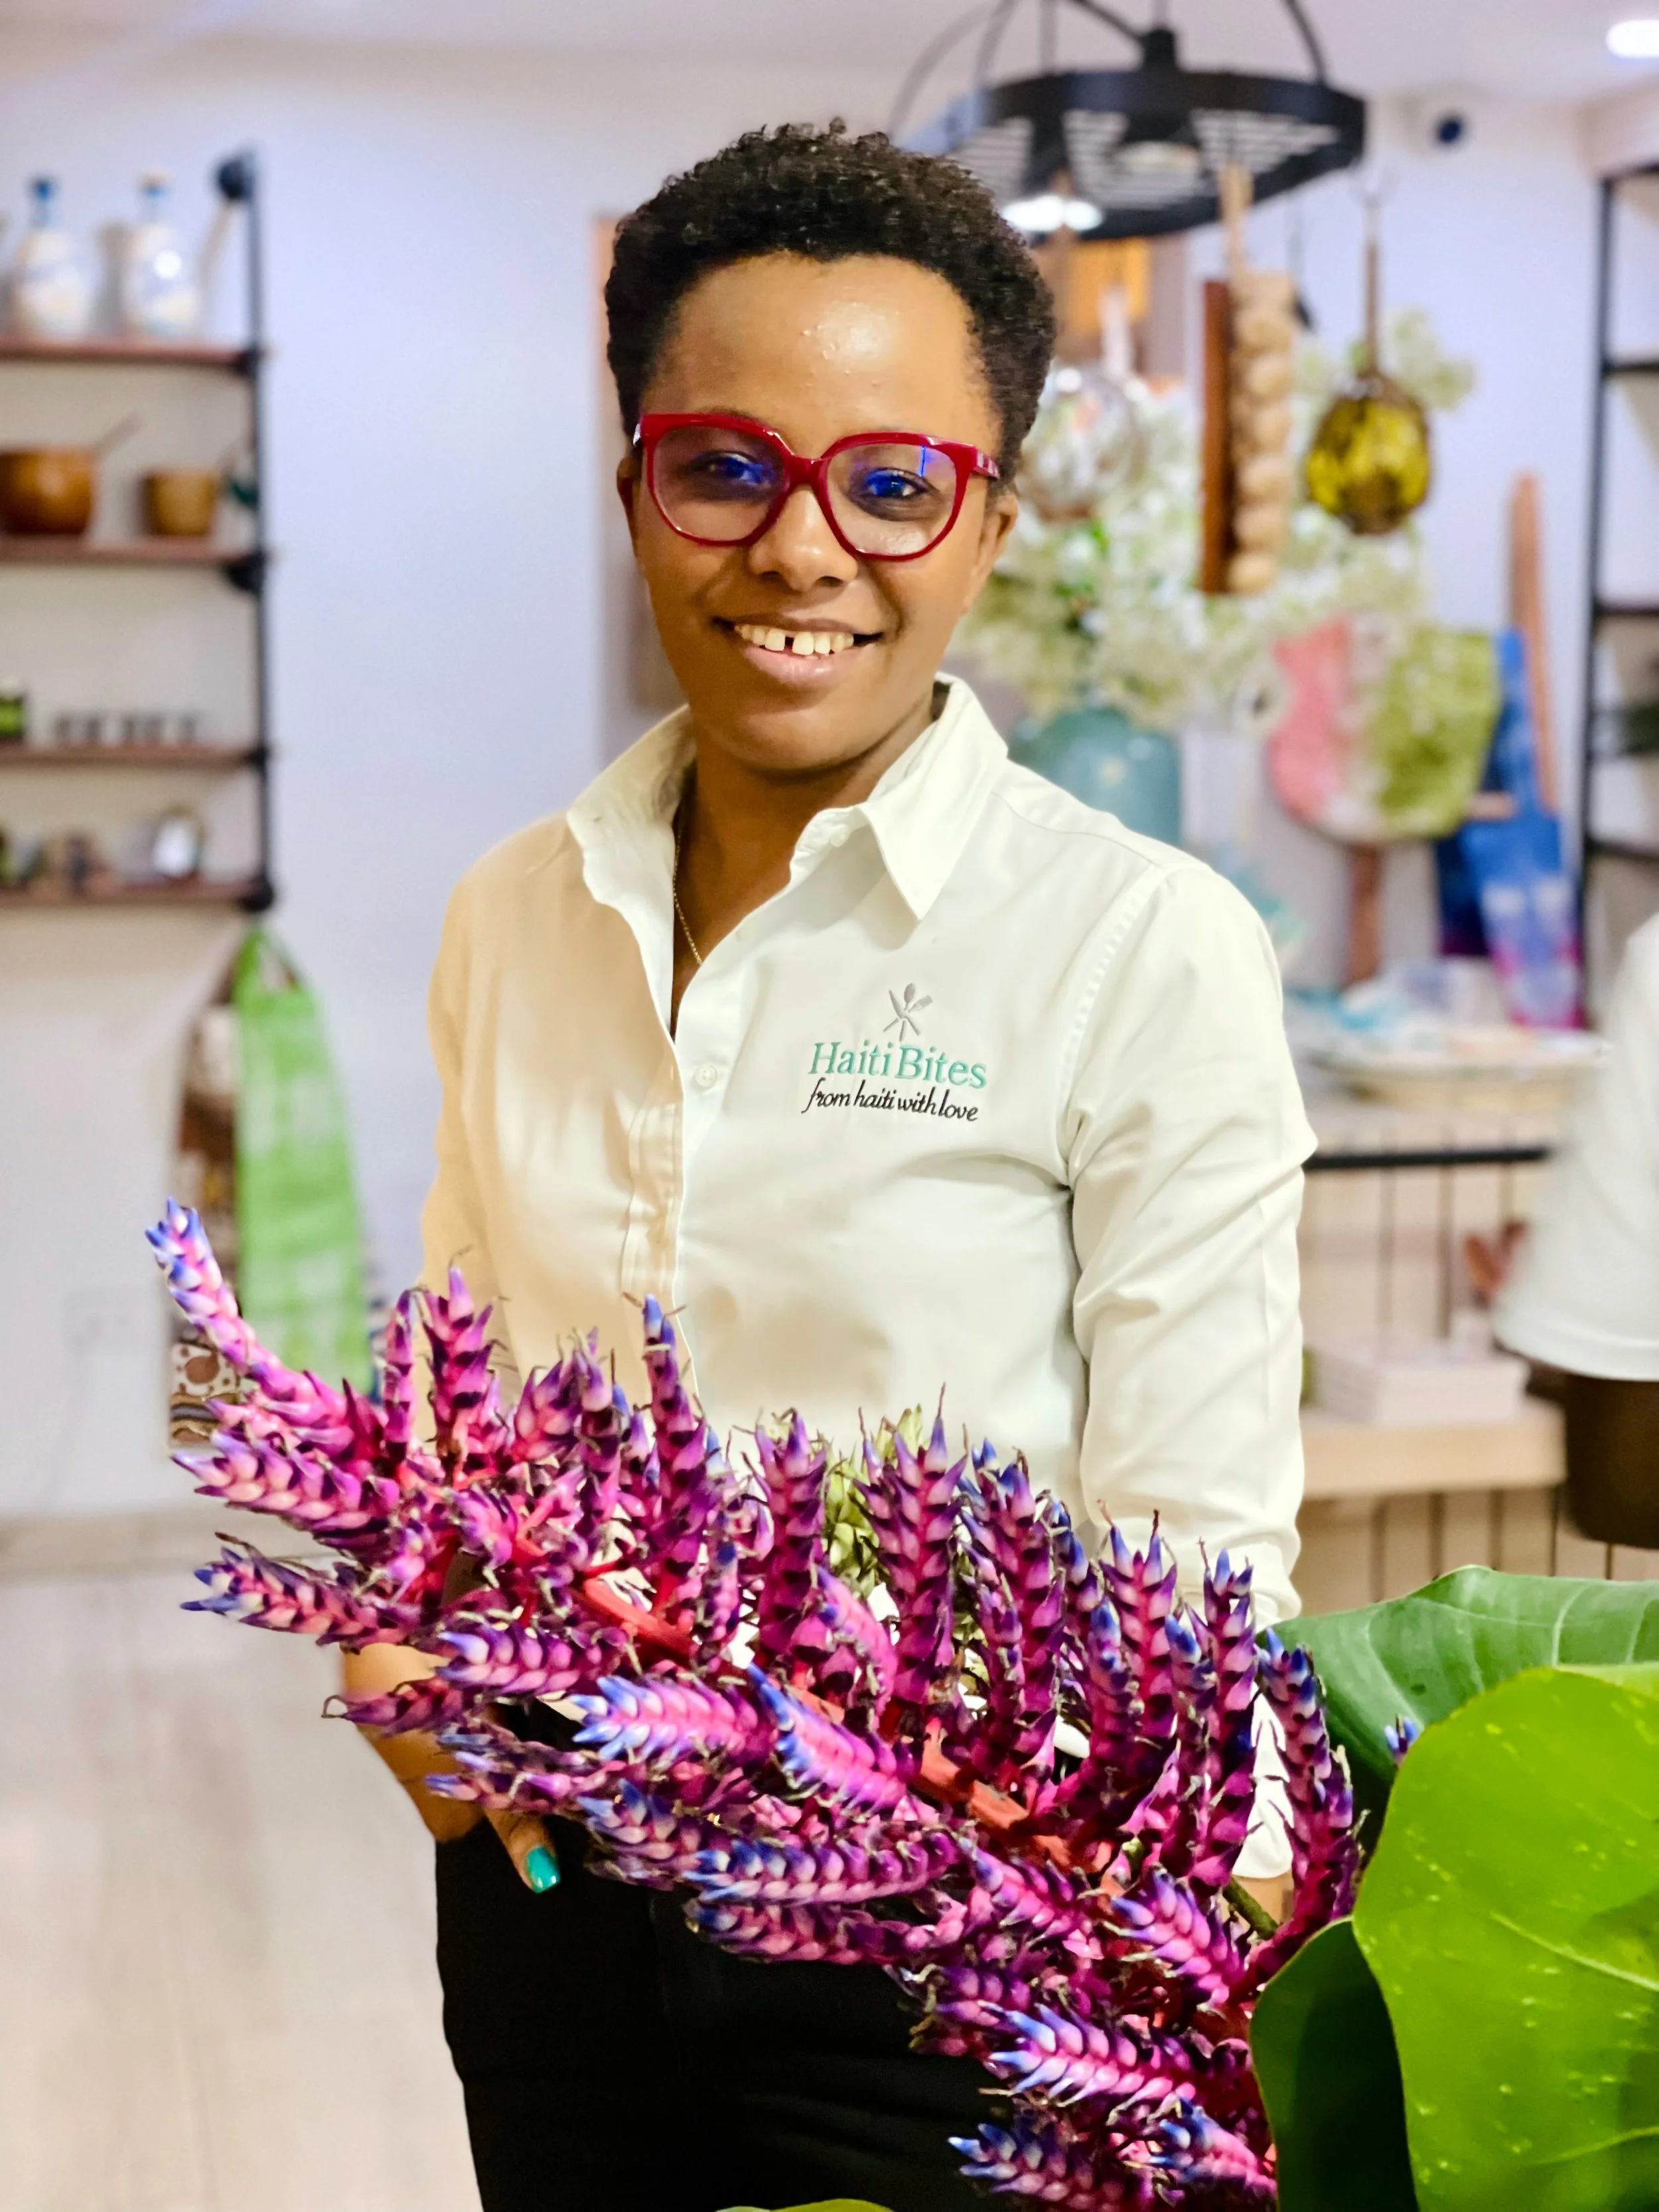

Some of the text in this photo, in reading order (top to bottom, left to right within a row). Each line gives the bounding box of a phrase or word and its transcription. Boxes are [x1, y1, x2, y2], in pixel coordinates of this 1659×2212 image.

[808, 1039, 987, 1089] Haiti Bites
[801, 1077, 979, 1122] from haiti with love
